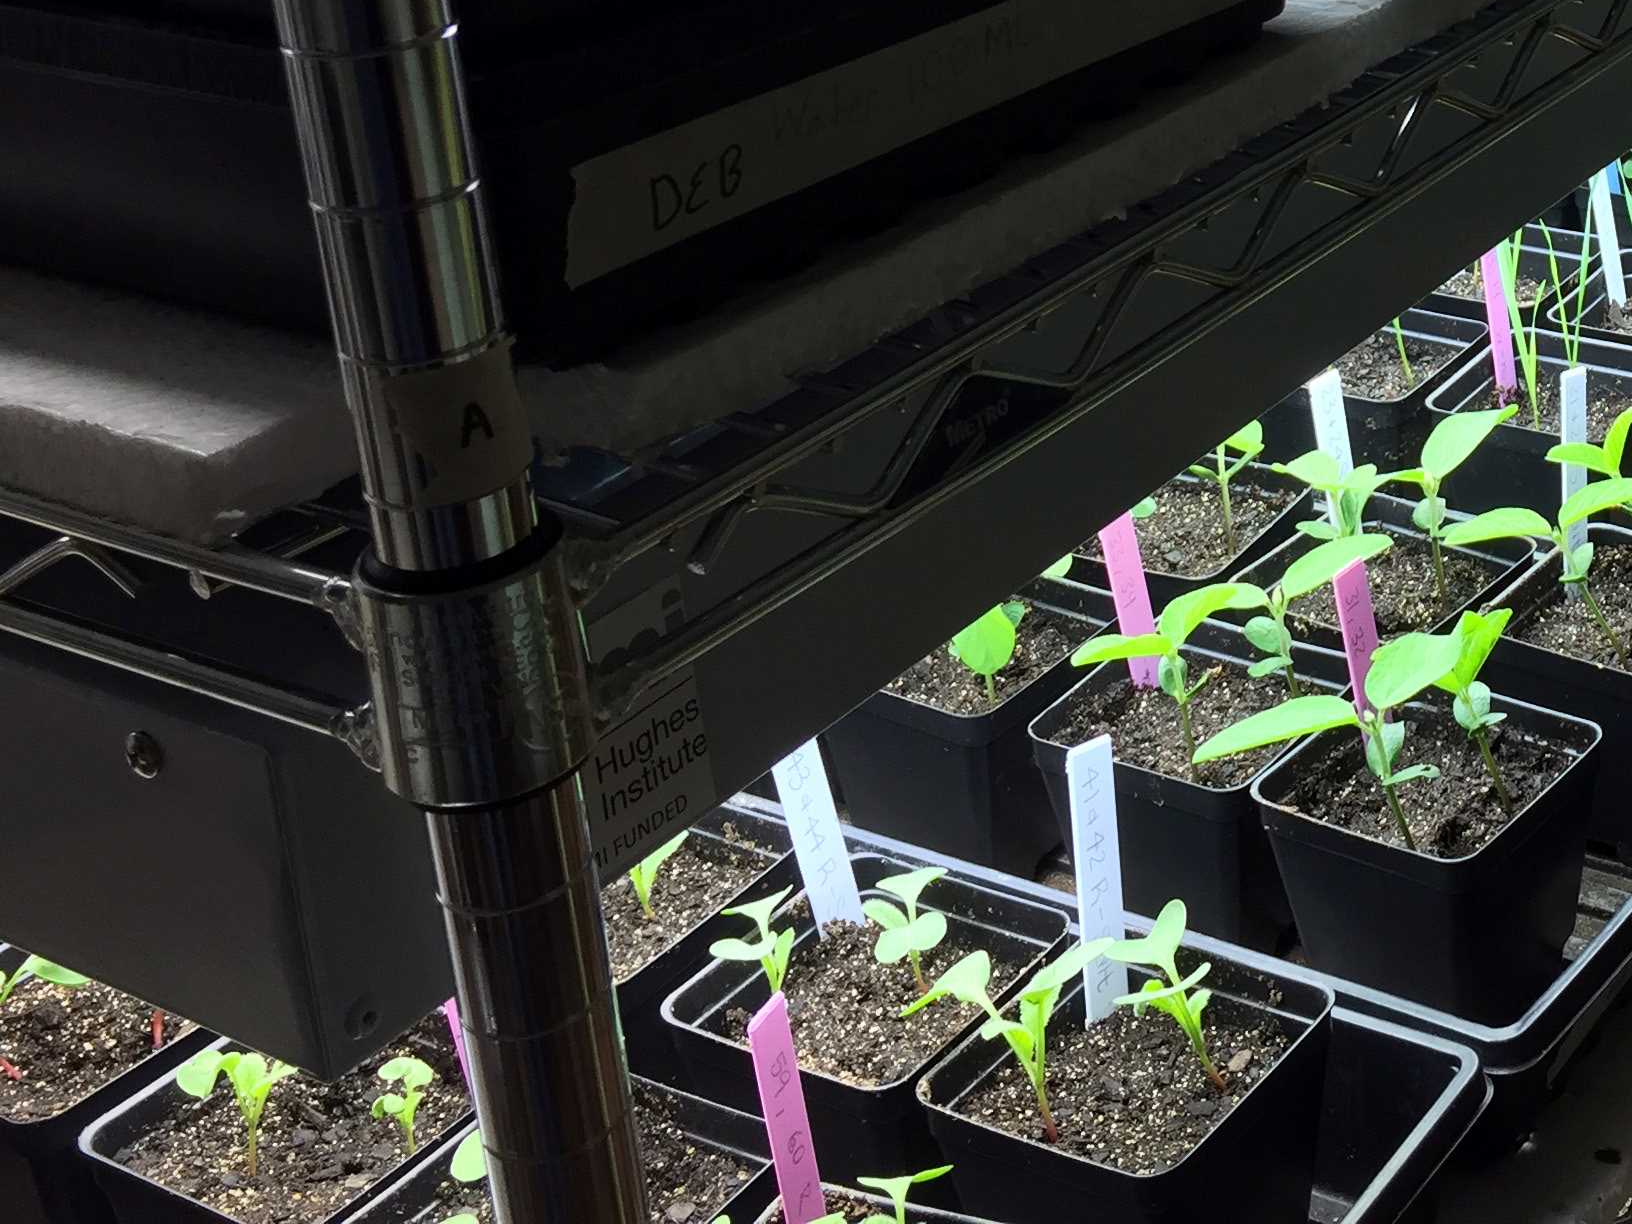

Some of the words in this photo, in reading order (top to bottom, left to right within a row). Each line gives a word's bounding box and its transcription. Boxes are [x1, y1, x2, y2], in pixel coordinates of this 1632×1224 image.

[649, 143, 743, 232] DEB
[460, 400, 495, 449] A
[943, 395, 1011, 449] METRO
[595, 698, 700, 785] Hughes
[601, 732, 709, 822] Institute
[612, 793, 689, 857] FUNDED
